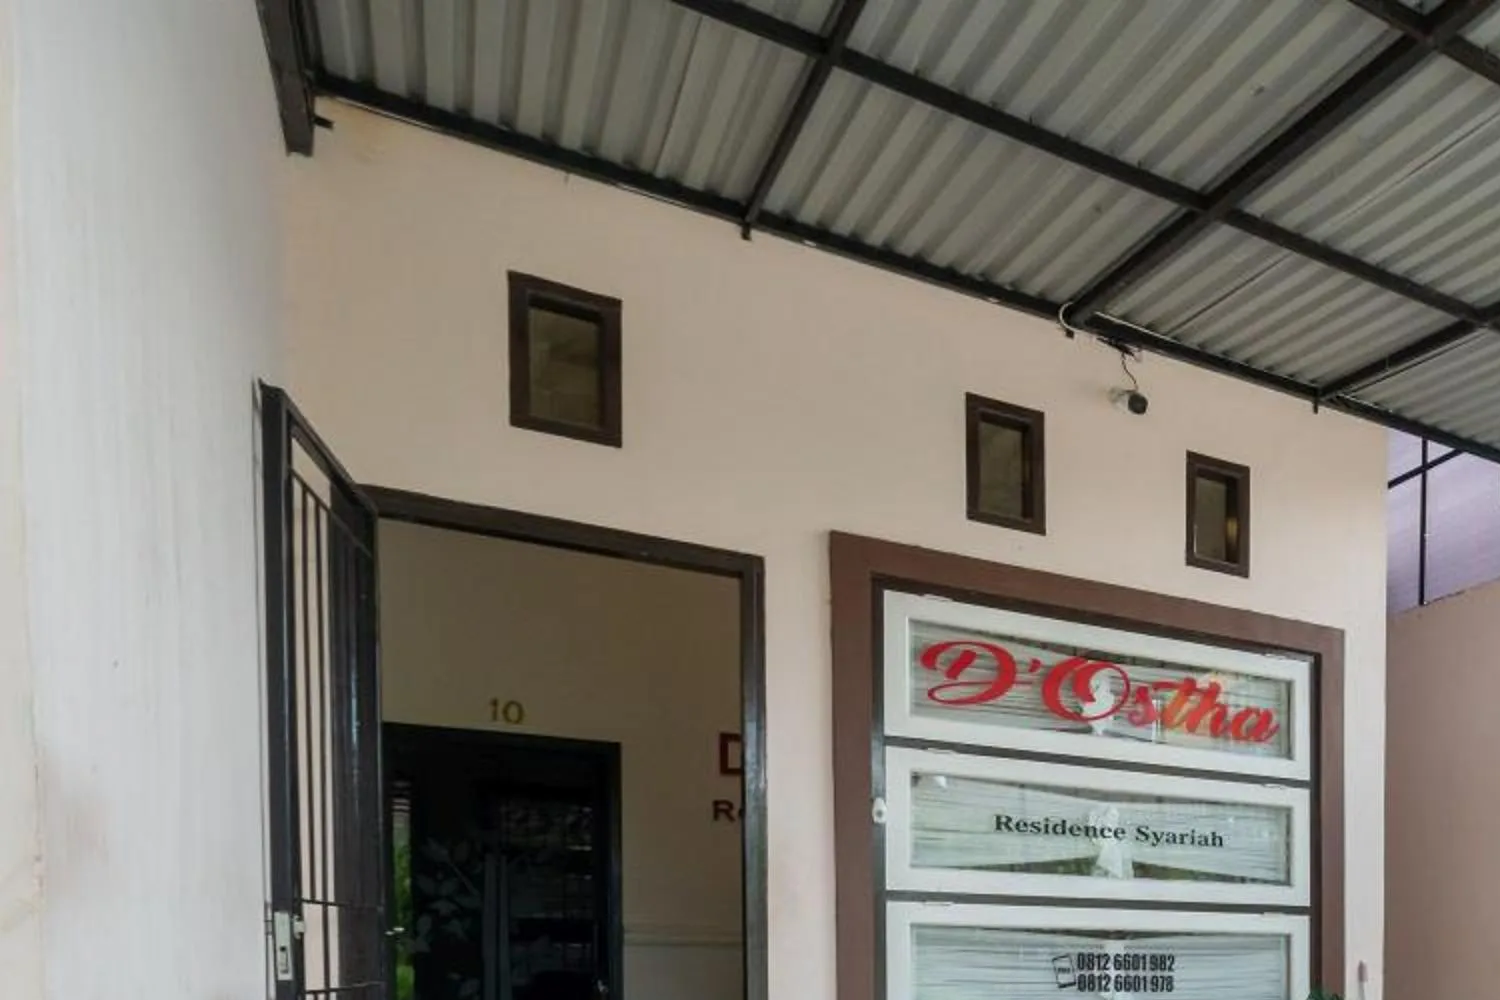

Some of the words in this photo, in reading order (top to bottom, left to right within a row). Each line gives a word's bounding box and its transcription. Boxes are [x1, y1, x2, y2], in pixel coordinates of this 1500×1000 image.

[489, 697, 525, 725] 10
[994, 814, 1127, 841] Residence
[1135, 825, 1224, 848] Syariah
